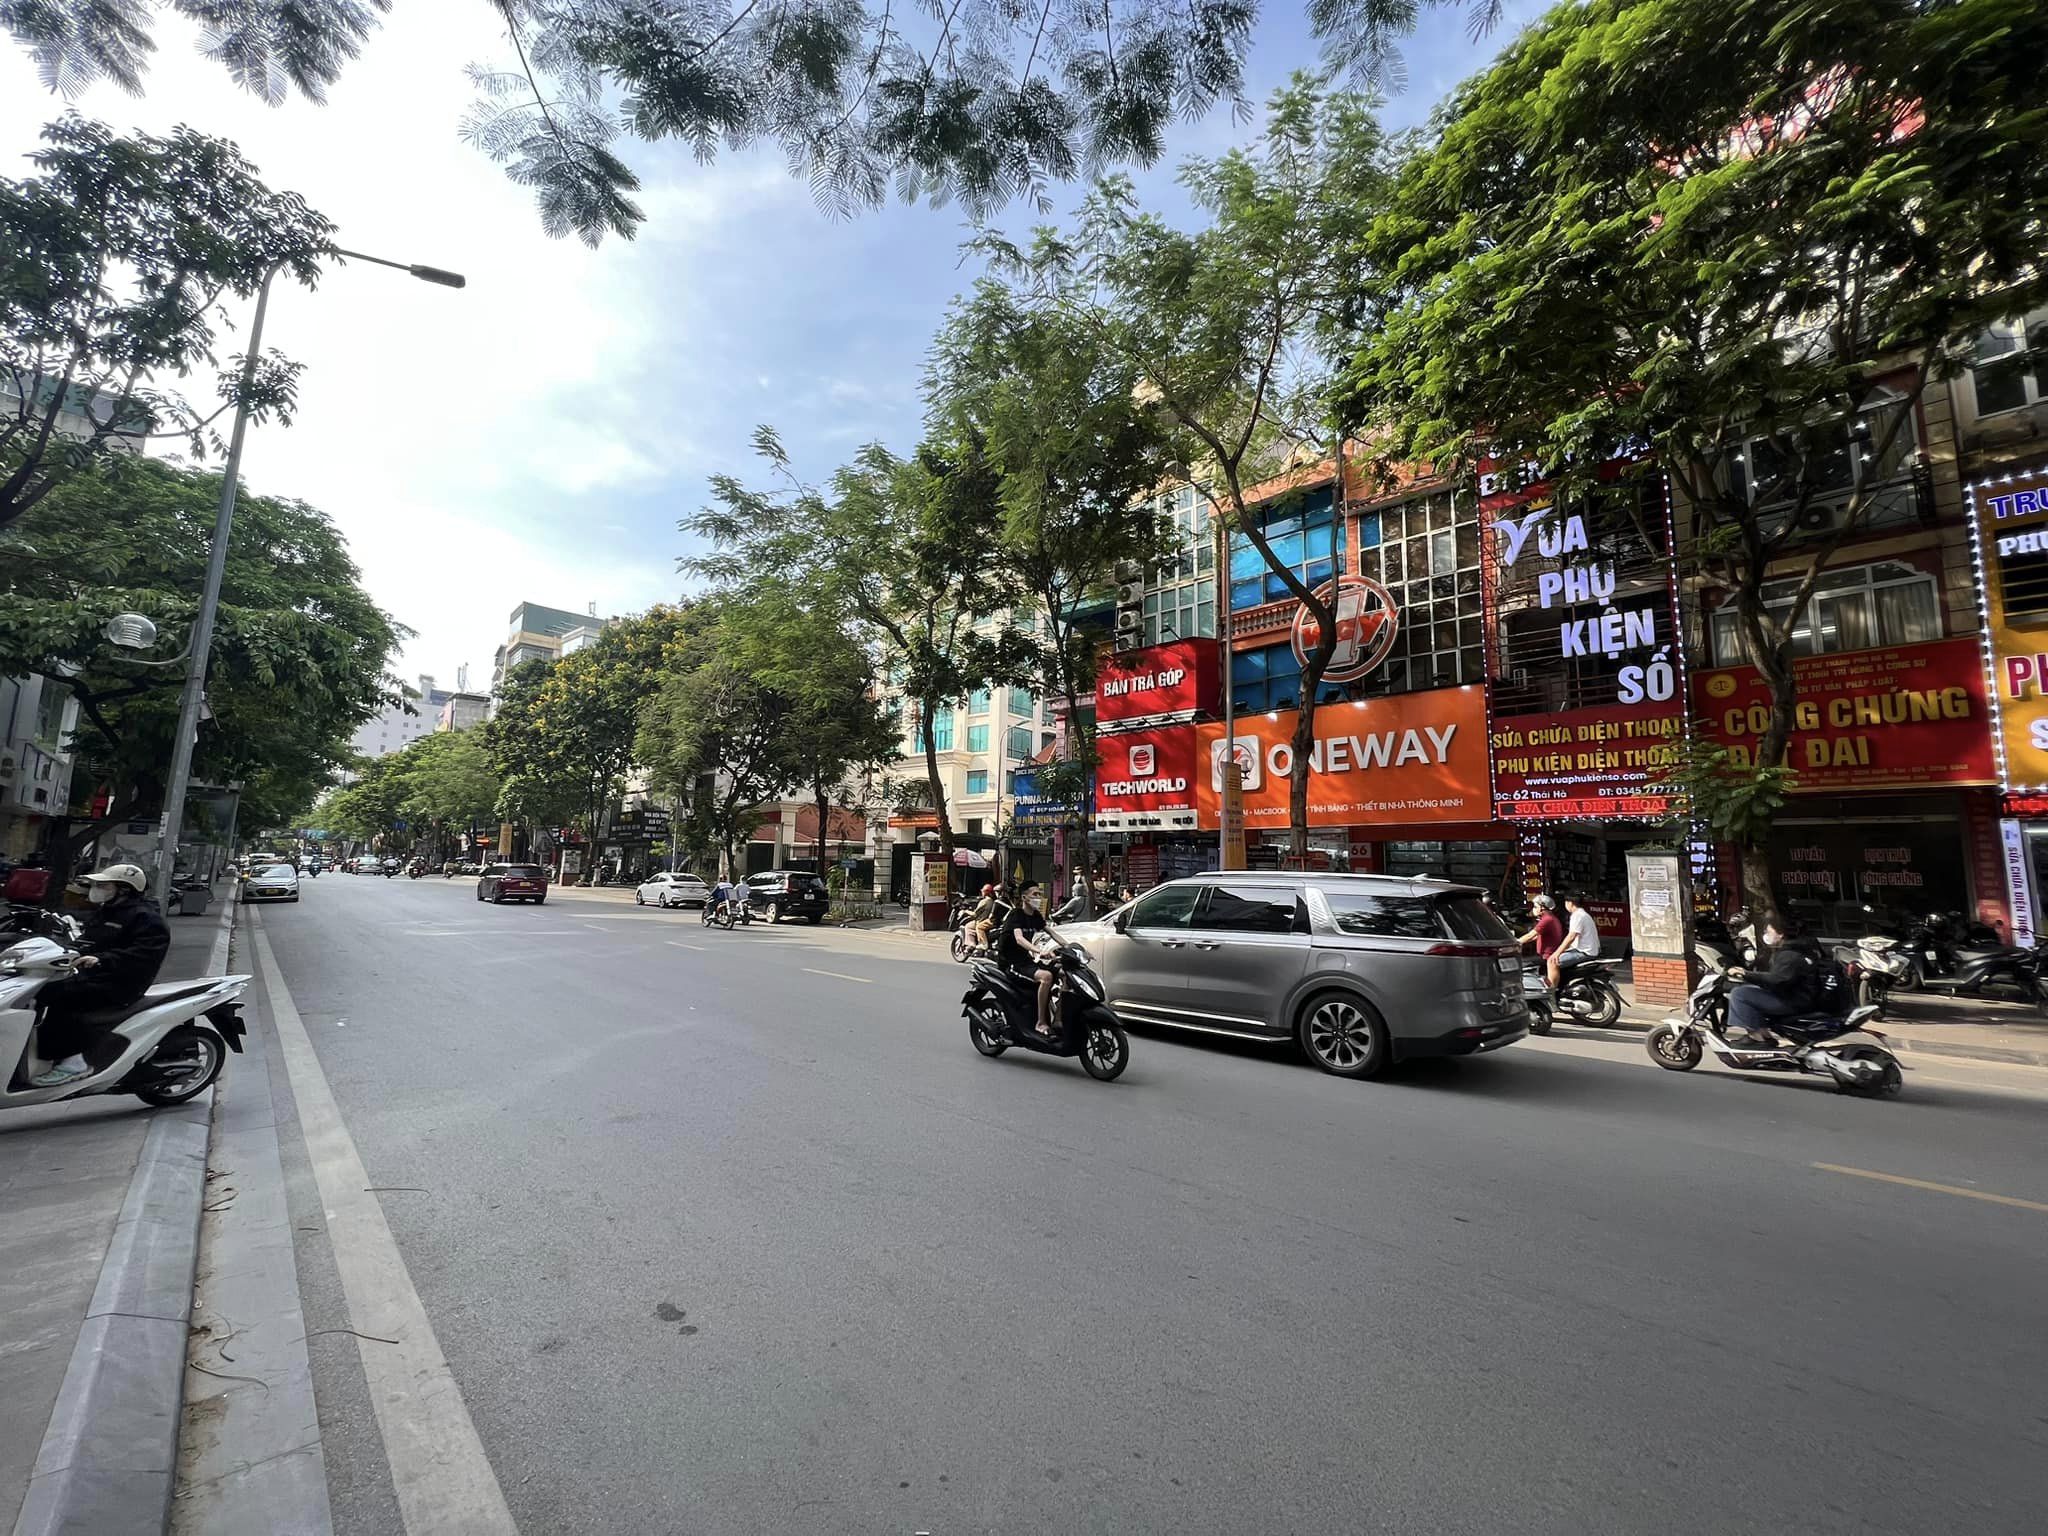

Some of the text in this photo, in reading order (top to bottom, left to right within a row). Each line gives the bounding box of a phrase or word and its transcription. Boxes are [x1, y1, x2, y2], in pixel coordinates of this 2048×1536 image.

[1538, 560, 1616, 608] PHỤ
[1560, 607, 1655, 660] KIỆN
[1104, 667, 1184, 697] BÁN TRẢ GÓP
[1617, 645, 1674, 704] SỐ
[1724, 686, 1970, 736] CÔG CHỨNG
[1493, 717, 1680, 748] SỬA CHỮA ĐIỆN THOẠI
[1497, 757, 1529, 776] PHỤ
[1533, 751, 1573, 775] KIỆN
[1577, 748, 1619, 772] ĐIỆN
[1806, 735, 1871, 768] ĐAI
[1102, 777, 1186, 796] TECHWORLD
[1513, 789, 1529, 800] 62
[1530, 790, 1550, 799] Thái
[1553, 790, 1567, 799] Hà
[1616, 787, 1642, 795] 0345
[1254, 807, 1287, 816] MACBOOK
[1310, 804, 1327, 813] TÍNH
[1328, 803, 1348, 812] BẢNG
[1357, 801, 1377, 811] THIẾT
[1379, 803, 1388, 811] BỊ
[1388, 800, 1406, 809] NHÀ
[1407, 799, 1438, 808] THÔNG
[1440, 799, 1464, 808] MINH
[1351, 845, 1367, 856] 66
[1523, 836, 1537, 844] 62
